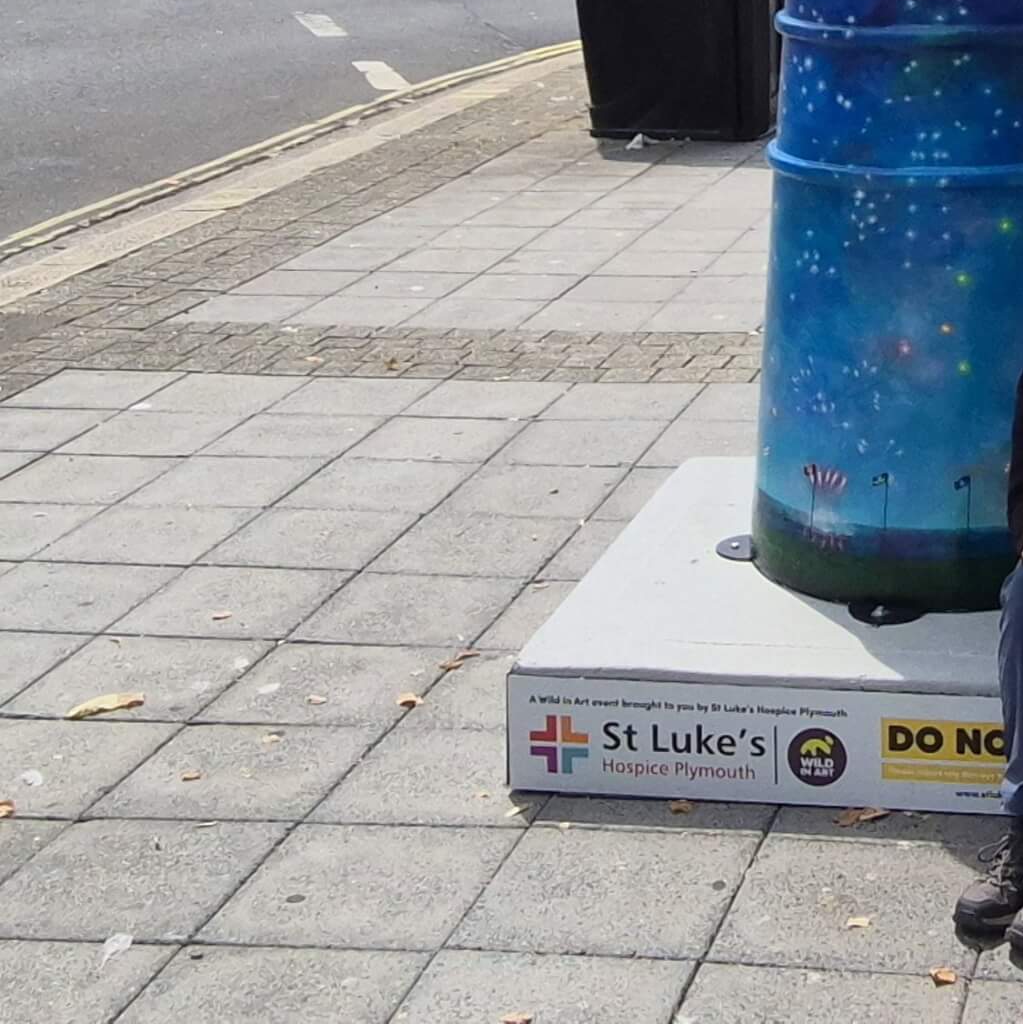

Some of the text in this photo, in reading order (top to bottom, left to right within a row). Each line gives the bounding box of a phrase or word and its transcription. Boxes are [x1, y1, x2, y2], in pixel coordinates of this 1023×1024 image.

[529, 695, 536, 704] A
[539, 695, 560, 705] Wild
[574, 697, 590, 707] Art
[592, 699, 619, 708] event
[622, 698, 662, 711] brought
[697, 702, 708, 714] by
[757, 705, 796, 716] Hospice
[602, 721, 767, 757] St Luke's
[888, 725, 1008, 757] DO NO
[602, 758, 756, 781] Hospice Plymouth
[800, 757, 834, 768] WILD
[800, 767, 834, 777] IN ART
